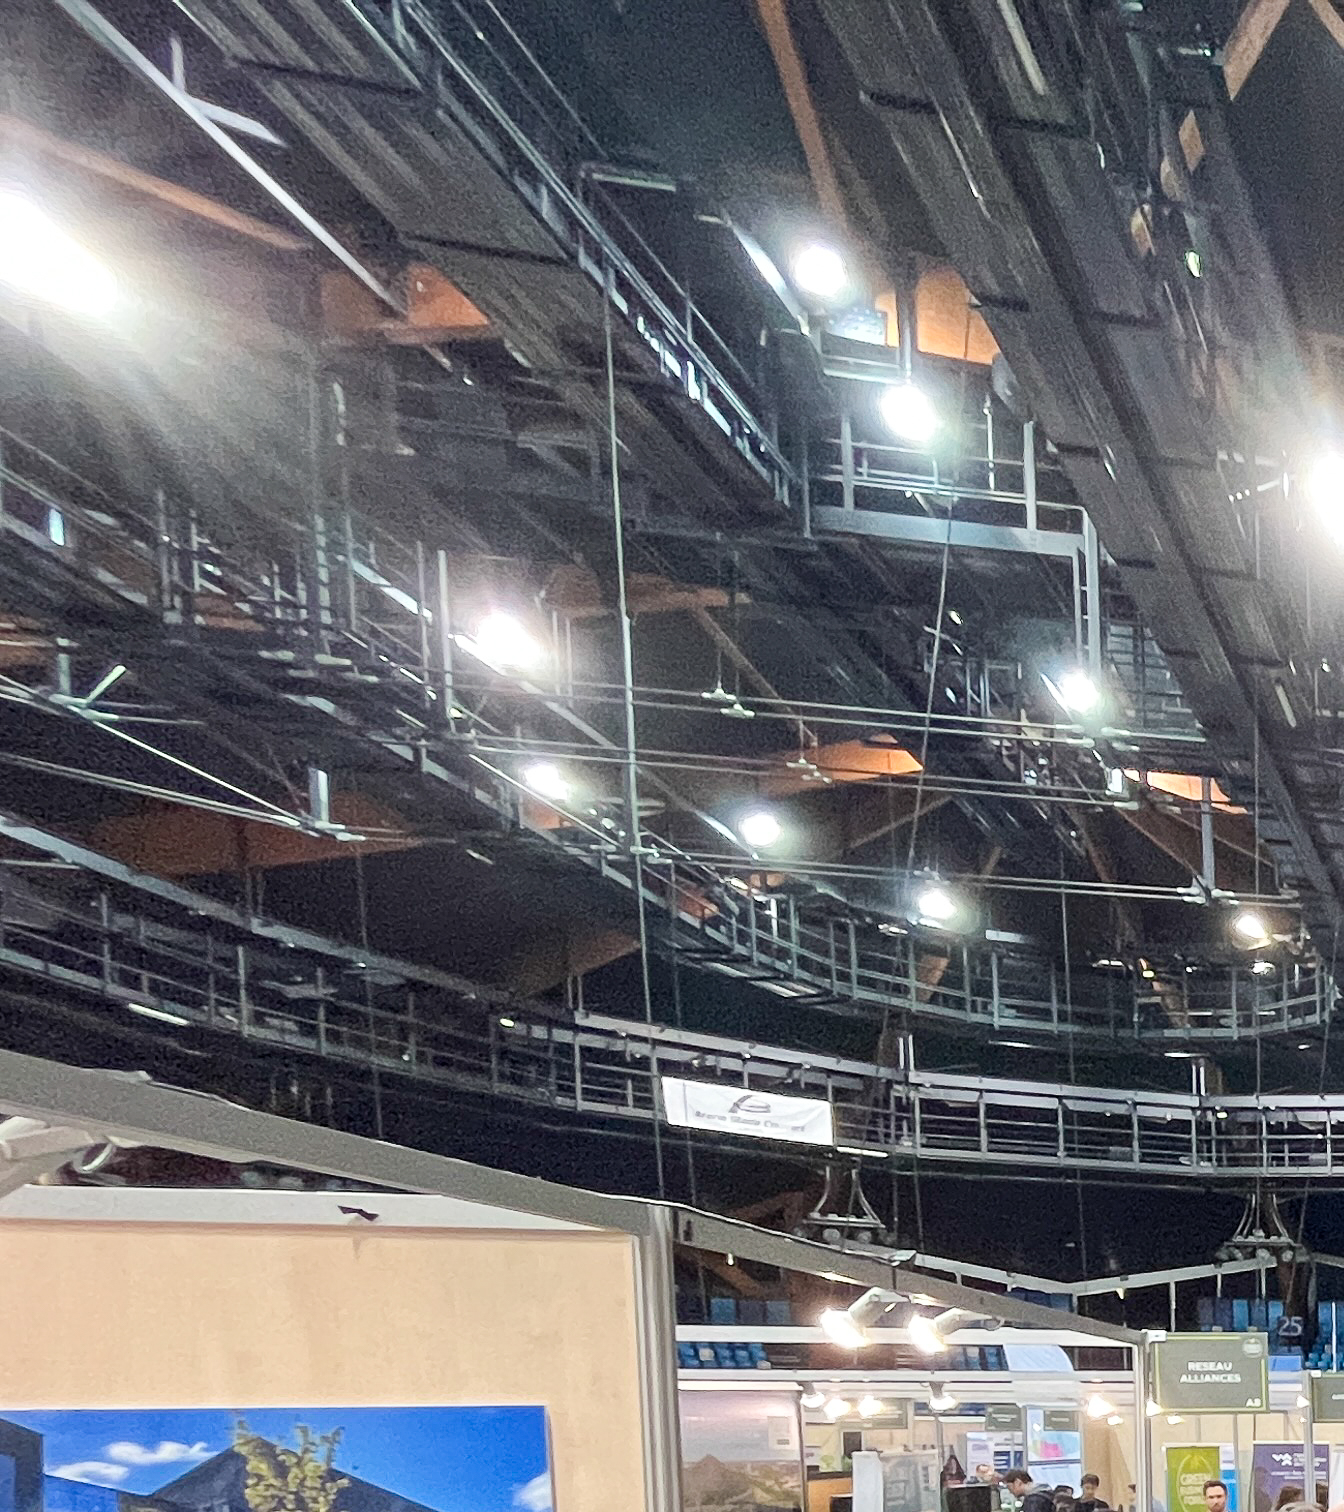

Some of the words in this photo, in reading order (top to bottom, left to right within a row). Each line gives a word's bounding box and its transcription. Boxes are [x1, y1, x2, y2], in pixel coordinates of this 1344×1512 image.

[1278, 1315, 1303, 1337] 25
[1187, 1361, 1233, 1372] RESEAU
[1179, 1373, 1242, 1384] ALLIANCES
